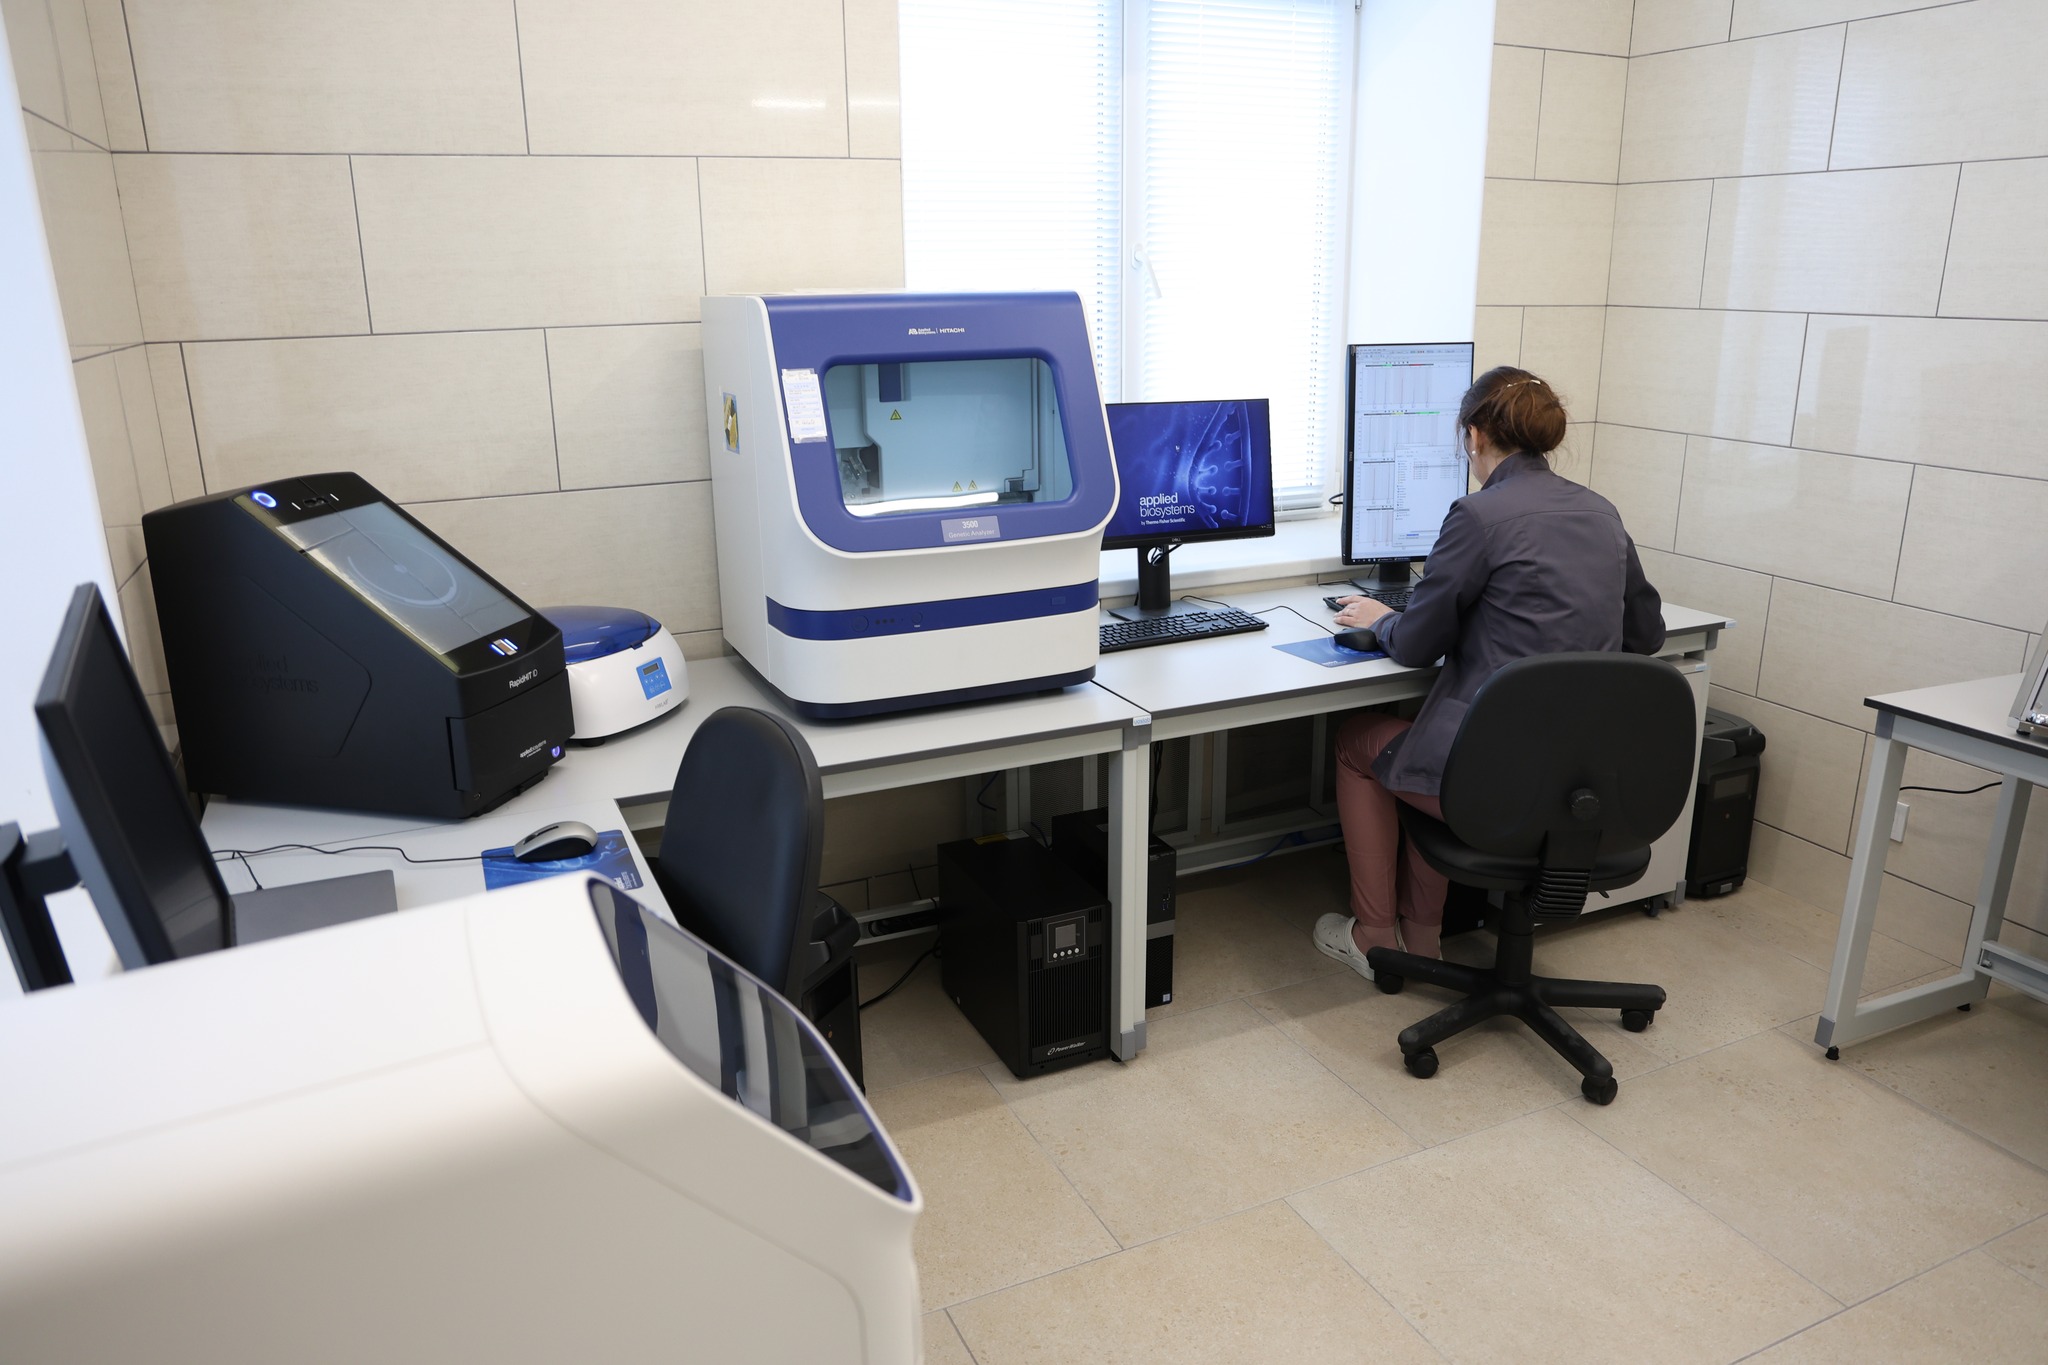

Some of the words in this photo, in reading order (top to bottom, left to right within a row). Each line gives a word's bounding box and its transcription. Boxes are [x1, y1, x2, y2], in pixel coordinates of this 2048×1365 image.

[1140, 492, 1178, 507] applied
[1140, 505, 1195, 518] biosystems
[962, 520, 978, 528] 3500
[509, 671, 532, 688] RapidHIT
